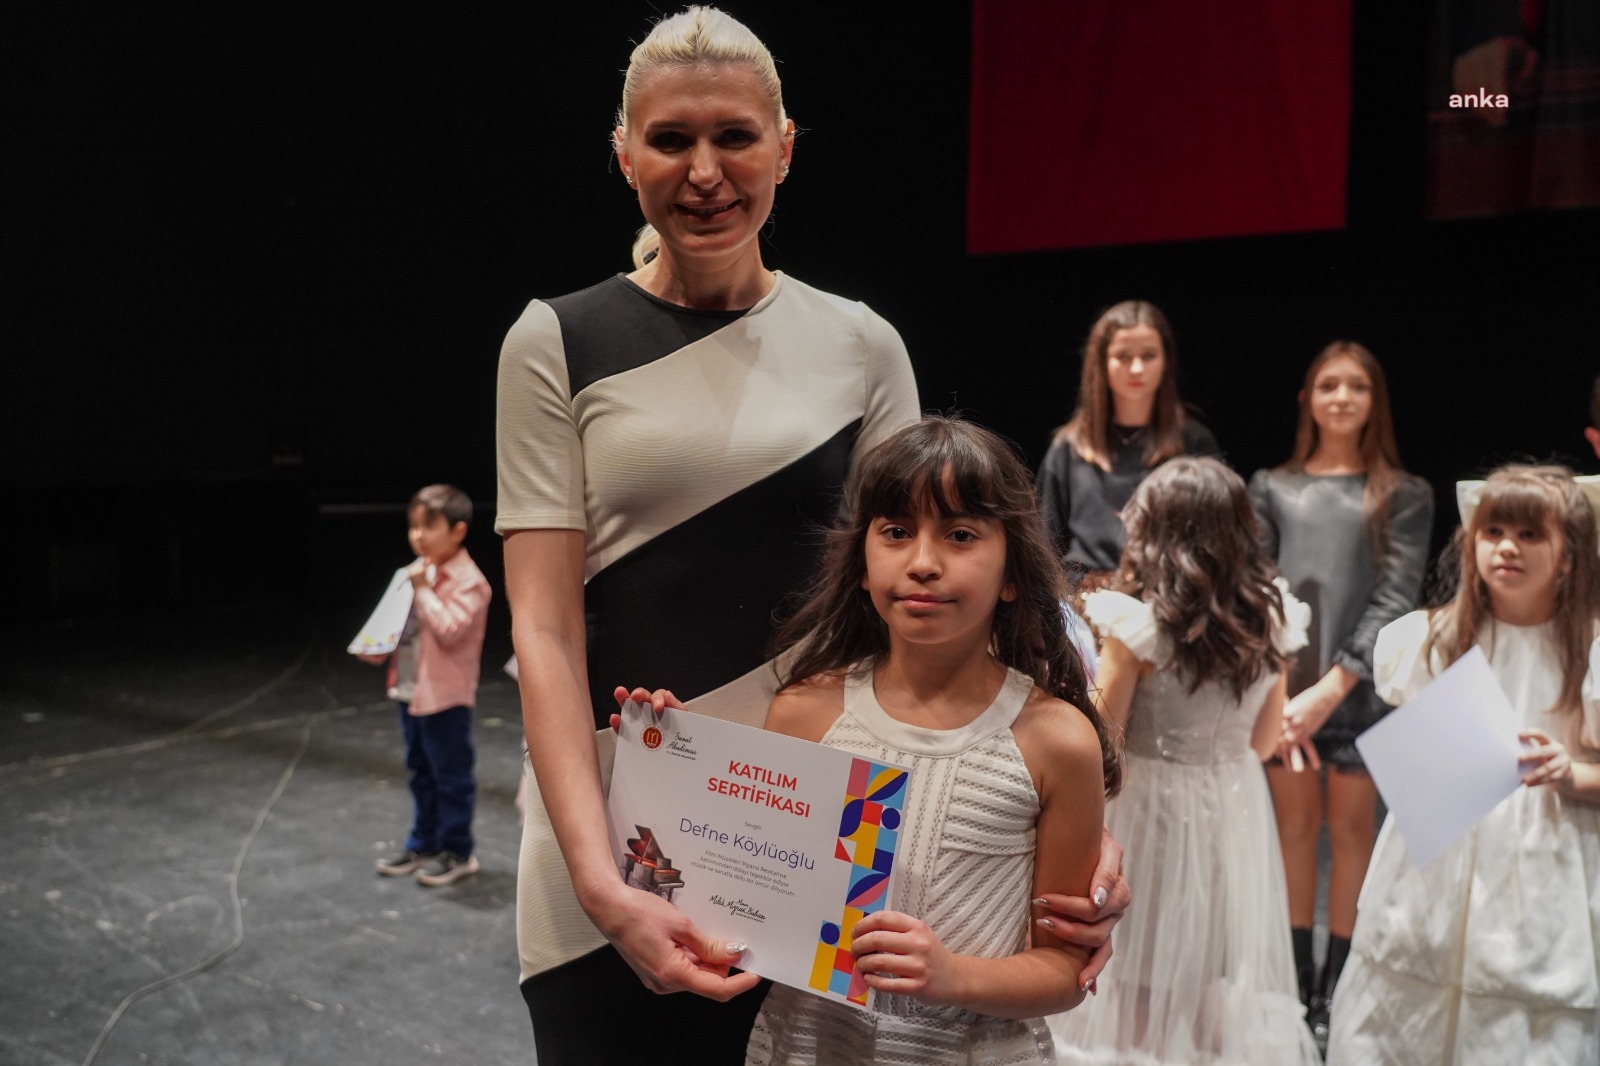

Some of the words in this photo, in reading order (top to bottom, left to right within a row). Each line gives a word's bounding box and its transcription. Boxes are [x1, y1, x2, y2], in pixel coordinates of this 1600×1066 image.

[729, 760, 798, 791] KATILIM
[707, 777, 811, 817] SERTİFİKASI
[679, 818, 729, 843] Defne
[733, 833, 815, 870] Köylüoğlu
